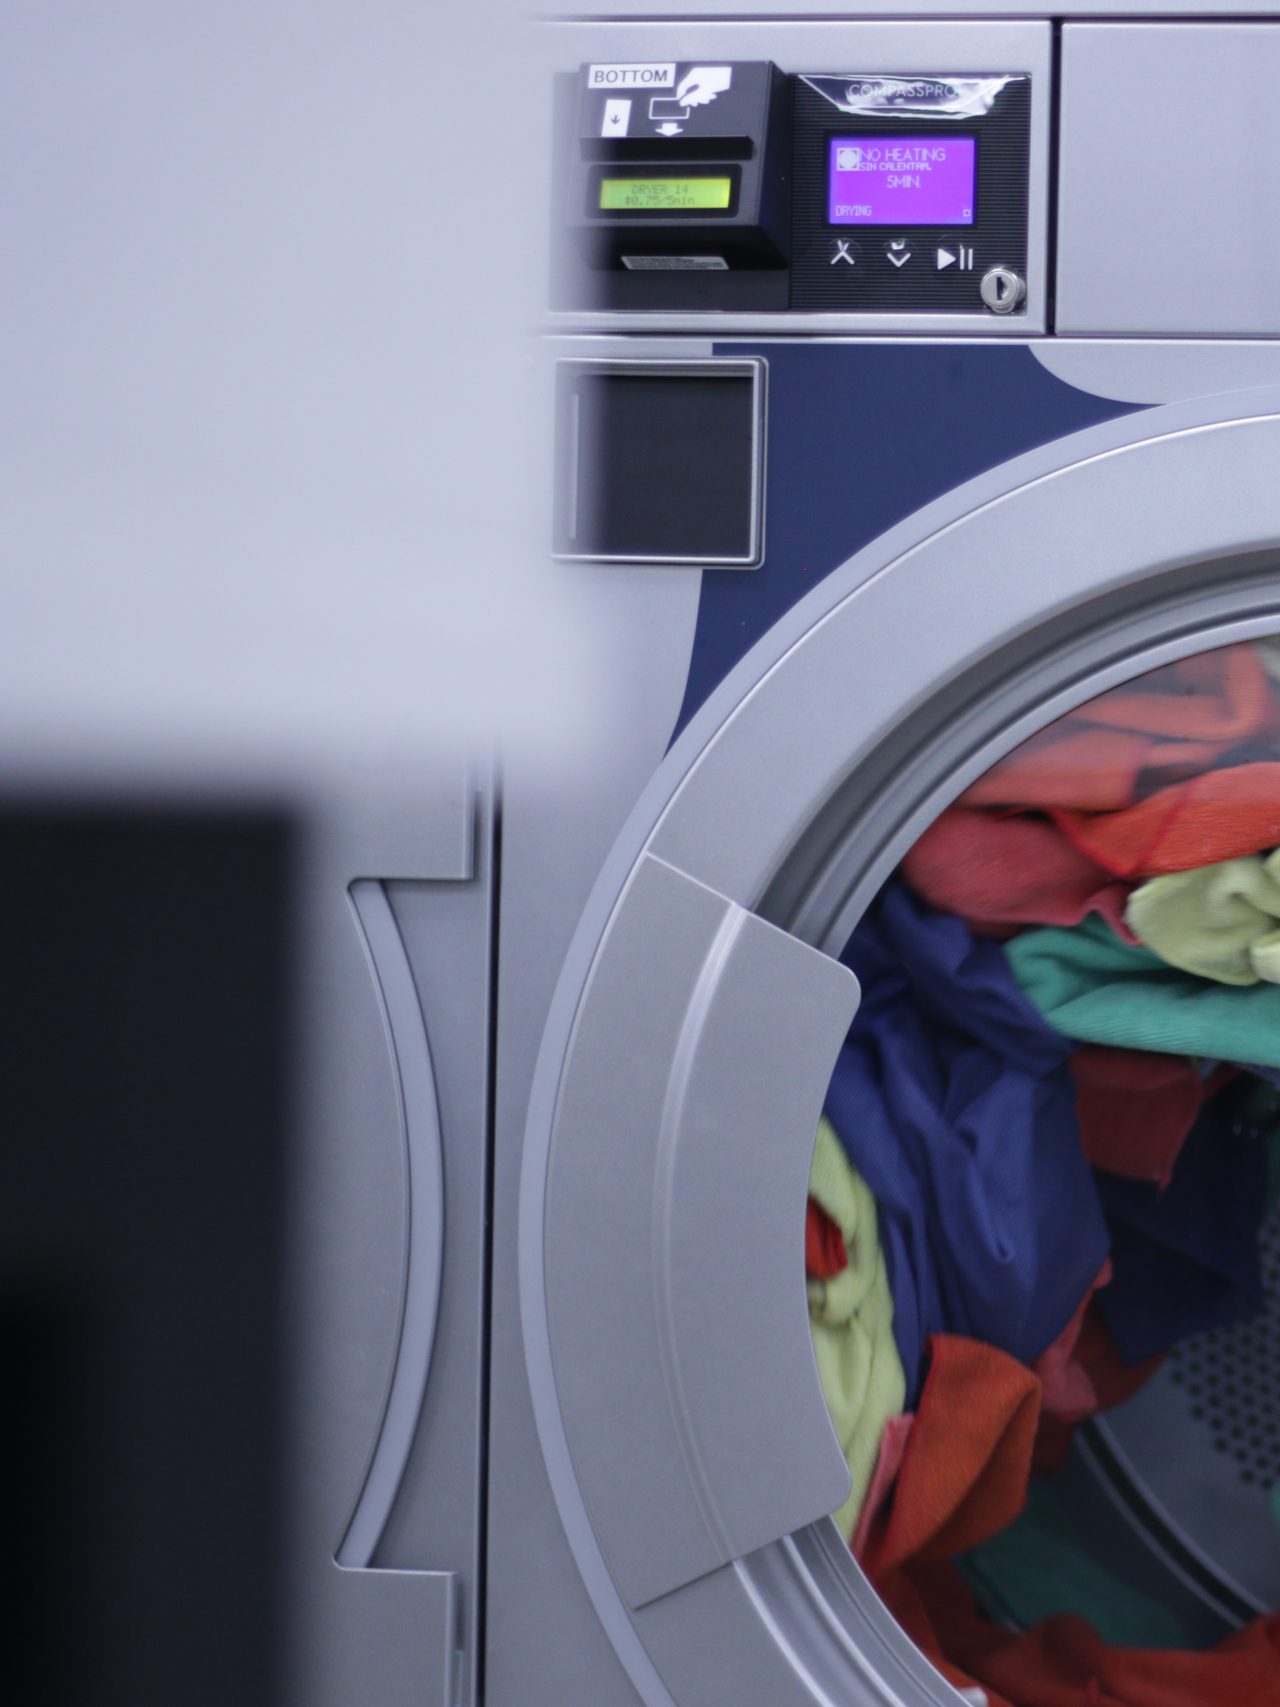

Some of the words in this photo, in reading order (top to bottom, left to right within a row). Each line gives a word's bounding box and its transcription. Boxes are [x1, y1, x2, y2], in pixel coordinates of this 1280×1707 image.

[594, 69, 668, 83] BOTTOM
[849, 84, 957, 98] COMPASSPRO
[860, 148, 881, 162] NO
[885, 148, 947, 162] HEATING
[859, 162, 877, 171] SIN
[835, 205, 872, 217] DRYING
